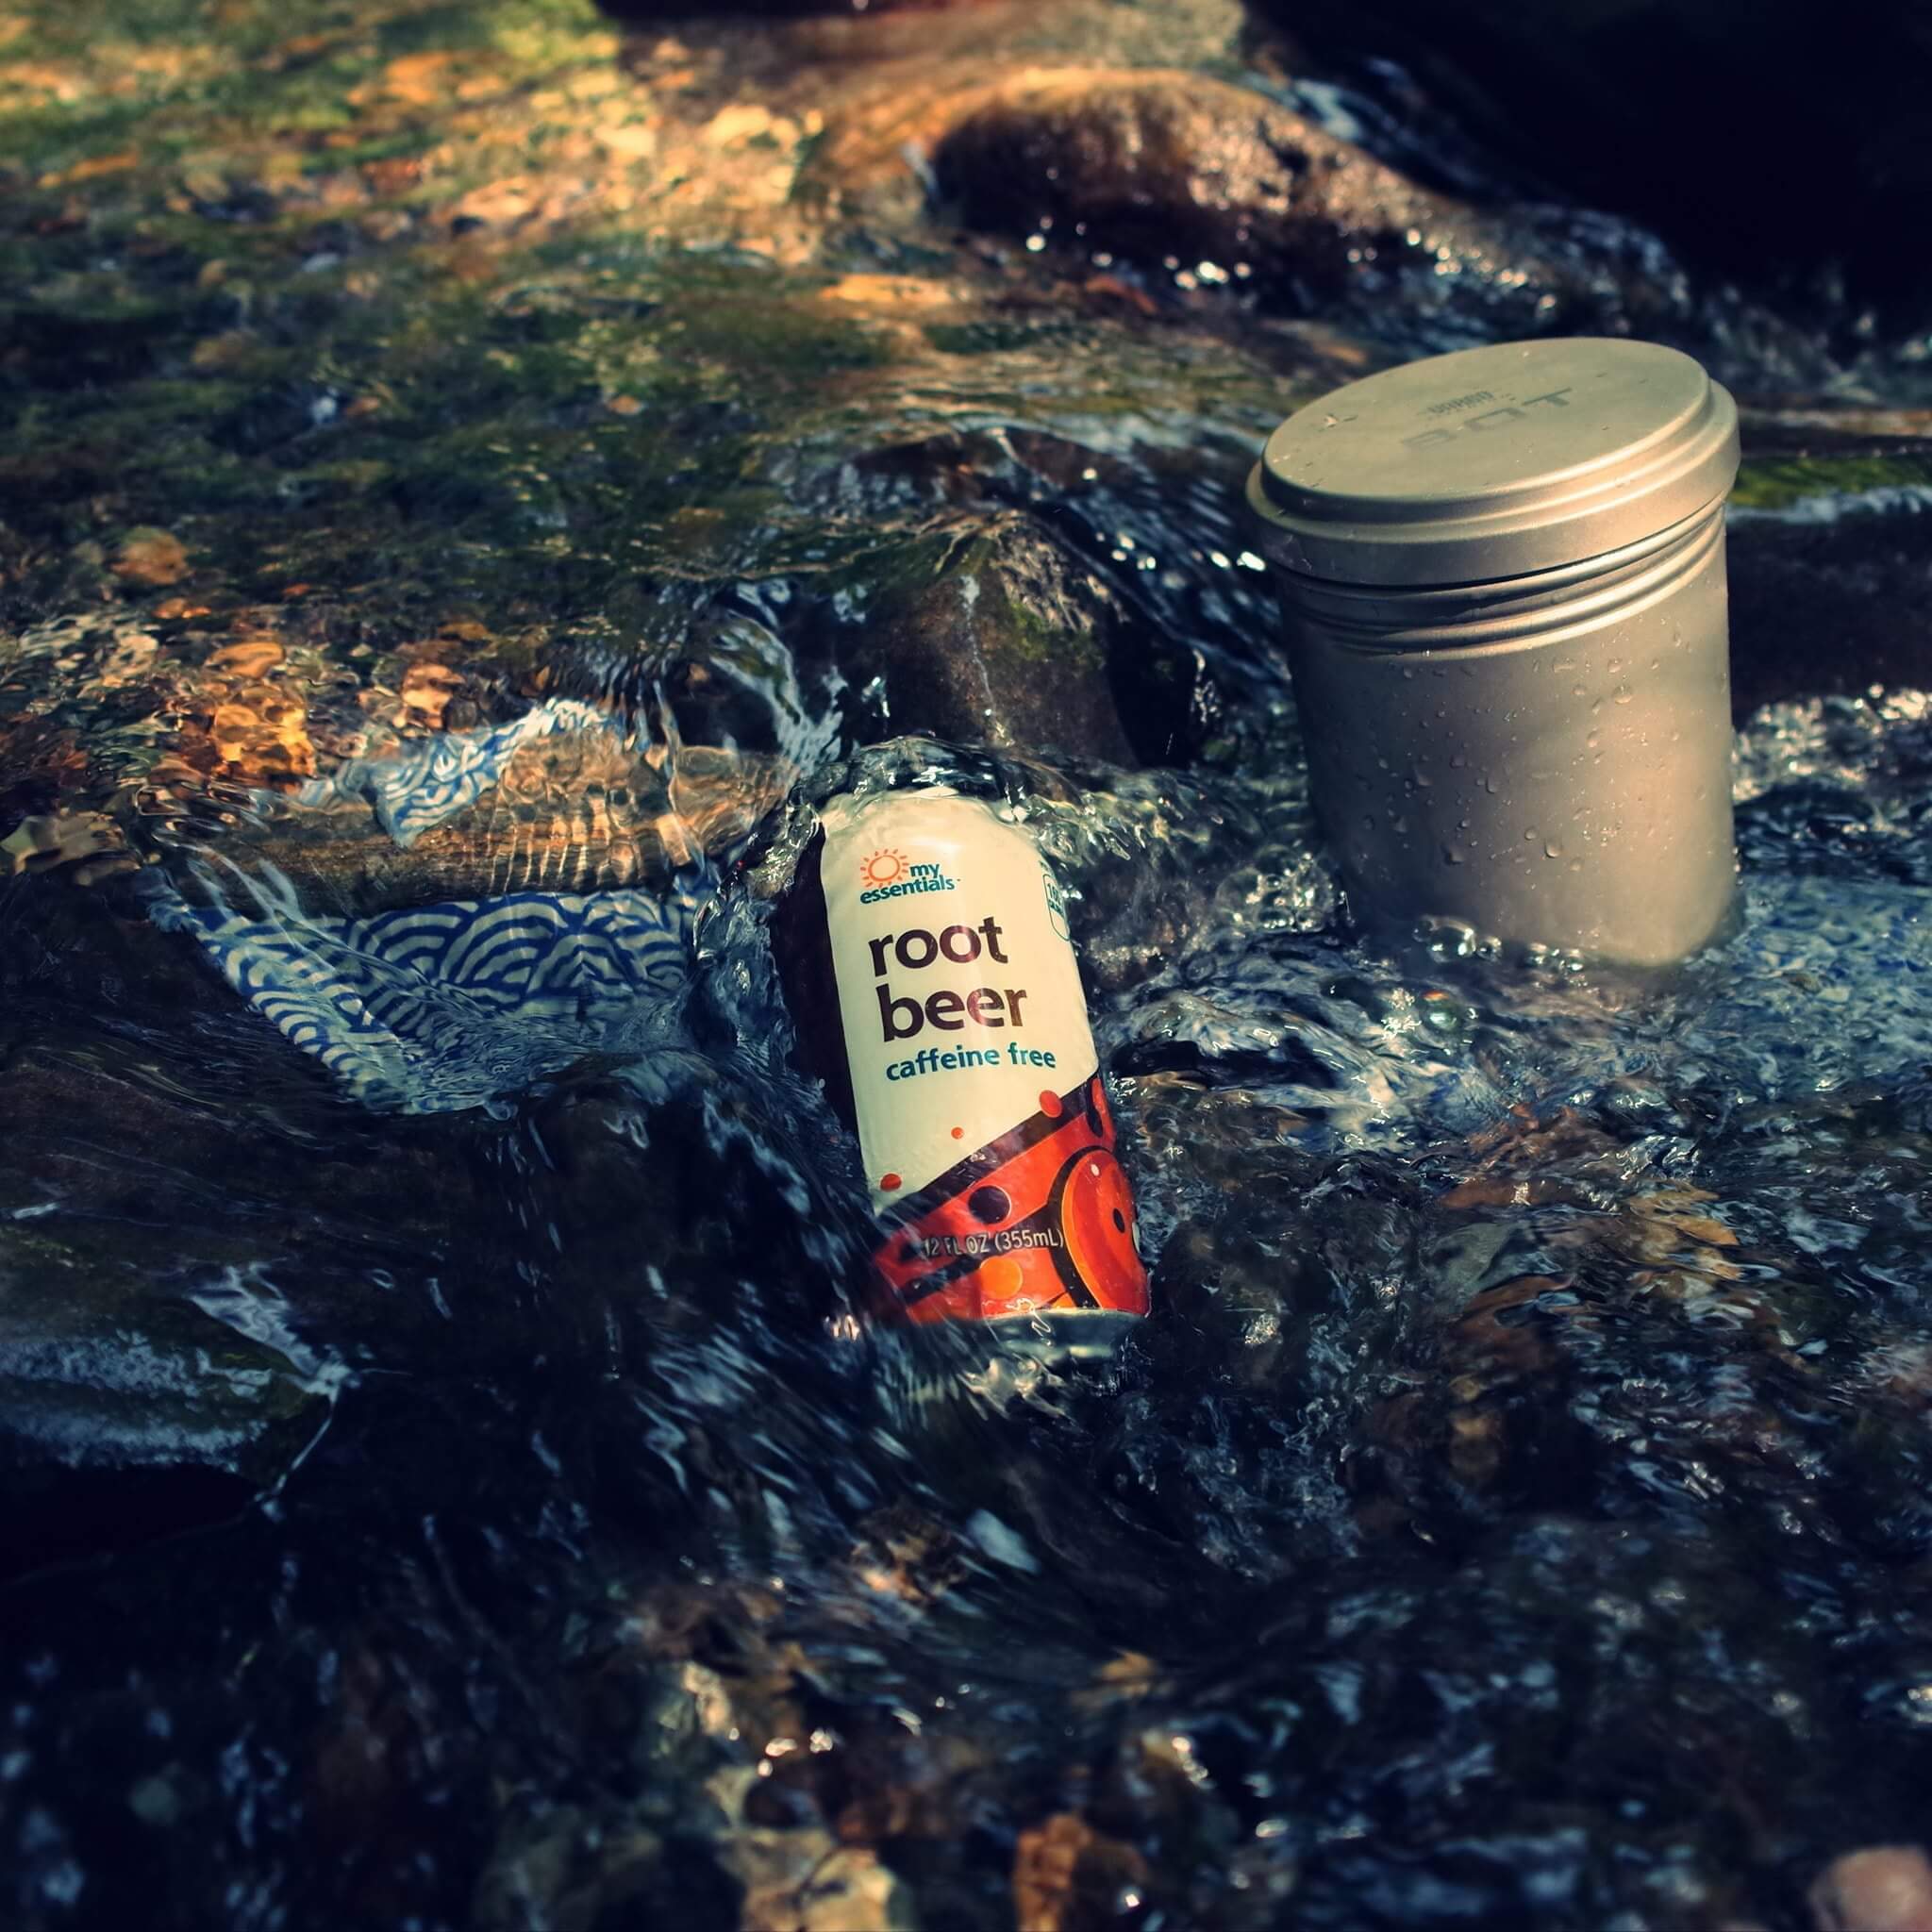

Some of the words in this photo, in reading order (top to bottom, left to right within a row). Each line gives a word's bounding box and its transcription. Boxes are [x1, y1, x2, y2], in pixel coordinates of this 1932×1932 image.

[909, 863, 941, 878] my
[859, 874, 956, 904] essentials
[868, 916, 1009, 978] root
[875, 983, 1028, 1043] beer
[886, 1044, 1001, 1081] caffeine
[1007, 1041, 1057, 1069] free
[924, 1237, 941, 1256] 12
[944, 1237, 963, 1256] FL
[966, 1234, 991, 1255] OZ
[994, 1227, 1065, 1253] (355mL)
